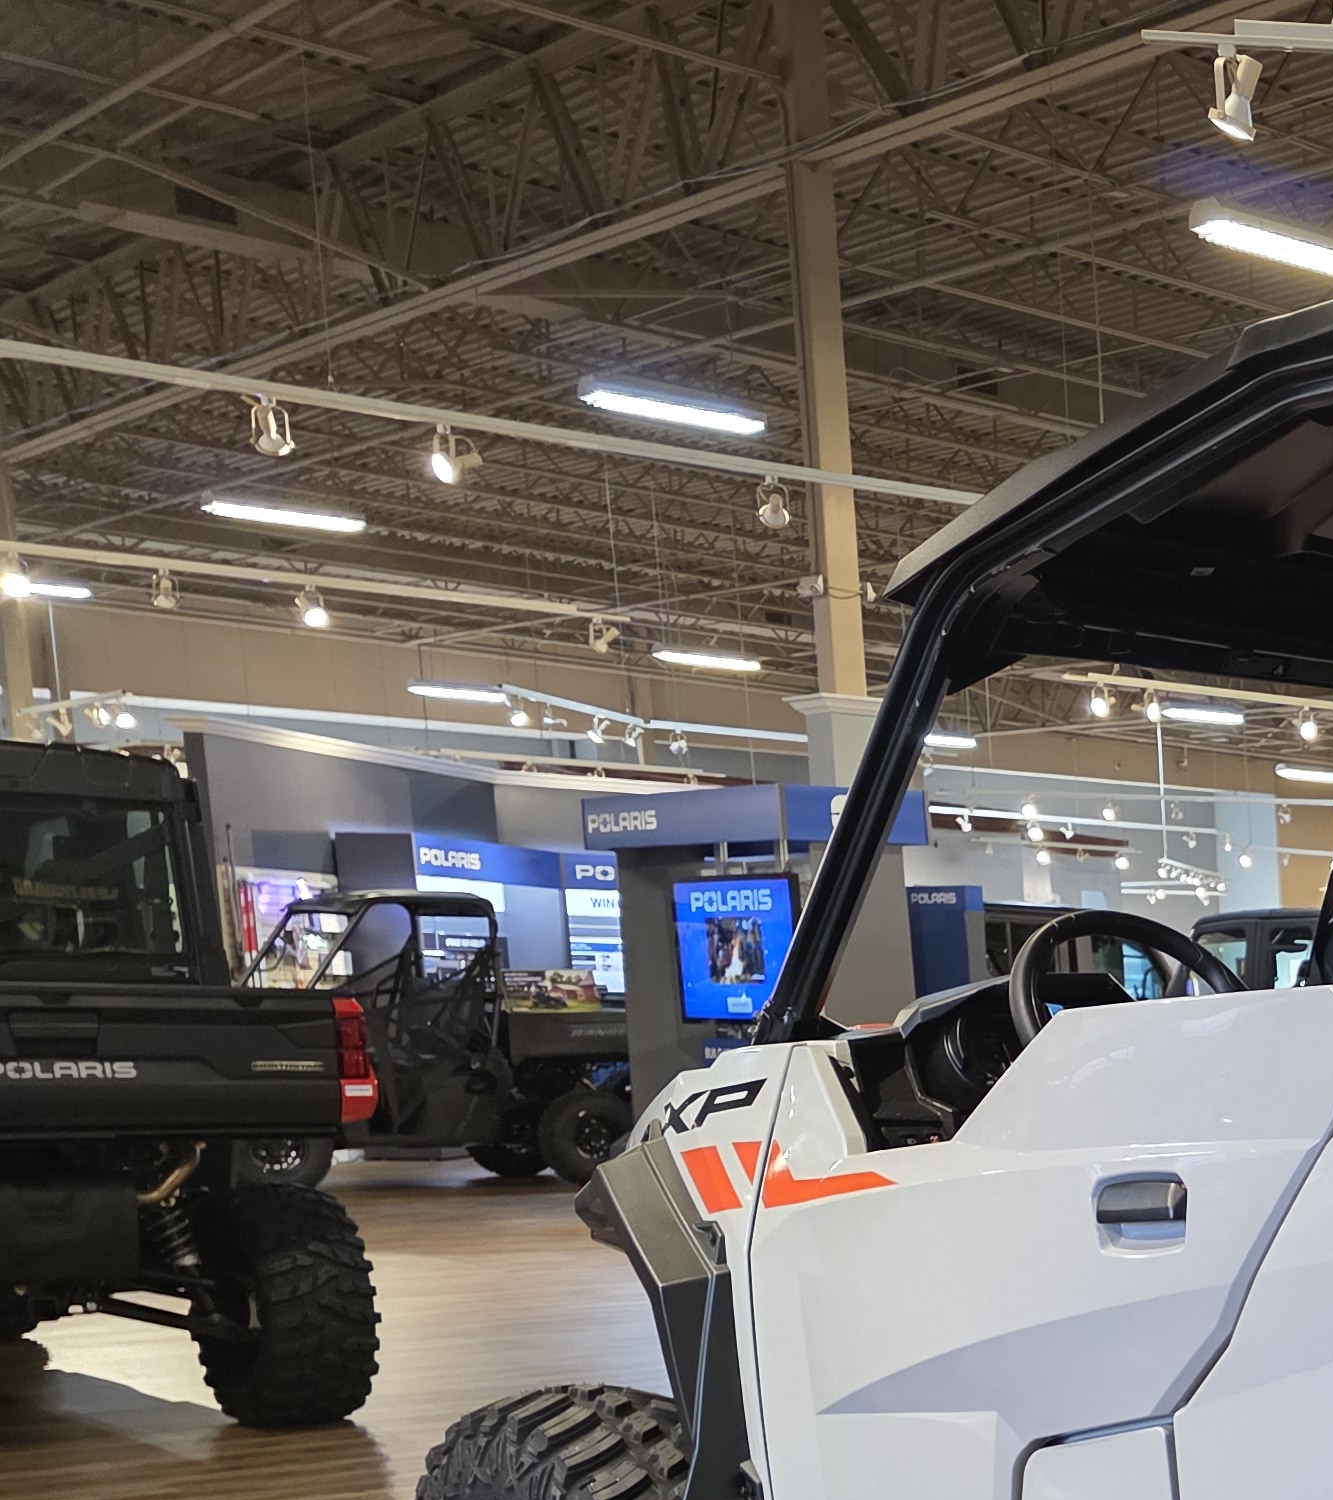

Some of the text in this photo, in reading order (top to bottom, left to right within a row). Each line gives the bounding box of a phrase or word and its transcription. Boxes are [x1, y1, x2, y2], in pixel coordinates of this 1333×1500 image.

[587, 809, 657, 834] POLARIS
[420, 846, 481, 870] POLARIS
[591, 897, 615, 908] WIN
[690, 888, 772, 913] POLARIS
[911, 892, 957, 905] POLARIS
[643, 1077, 768, 1141] XP
